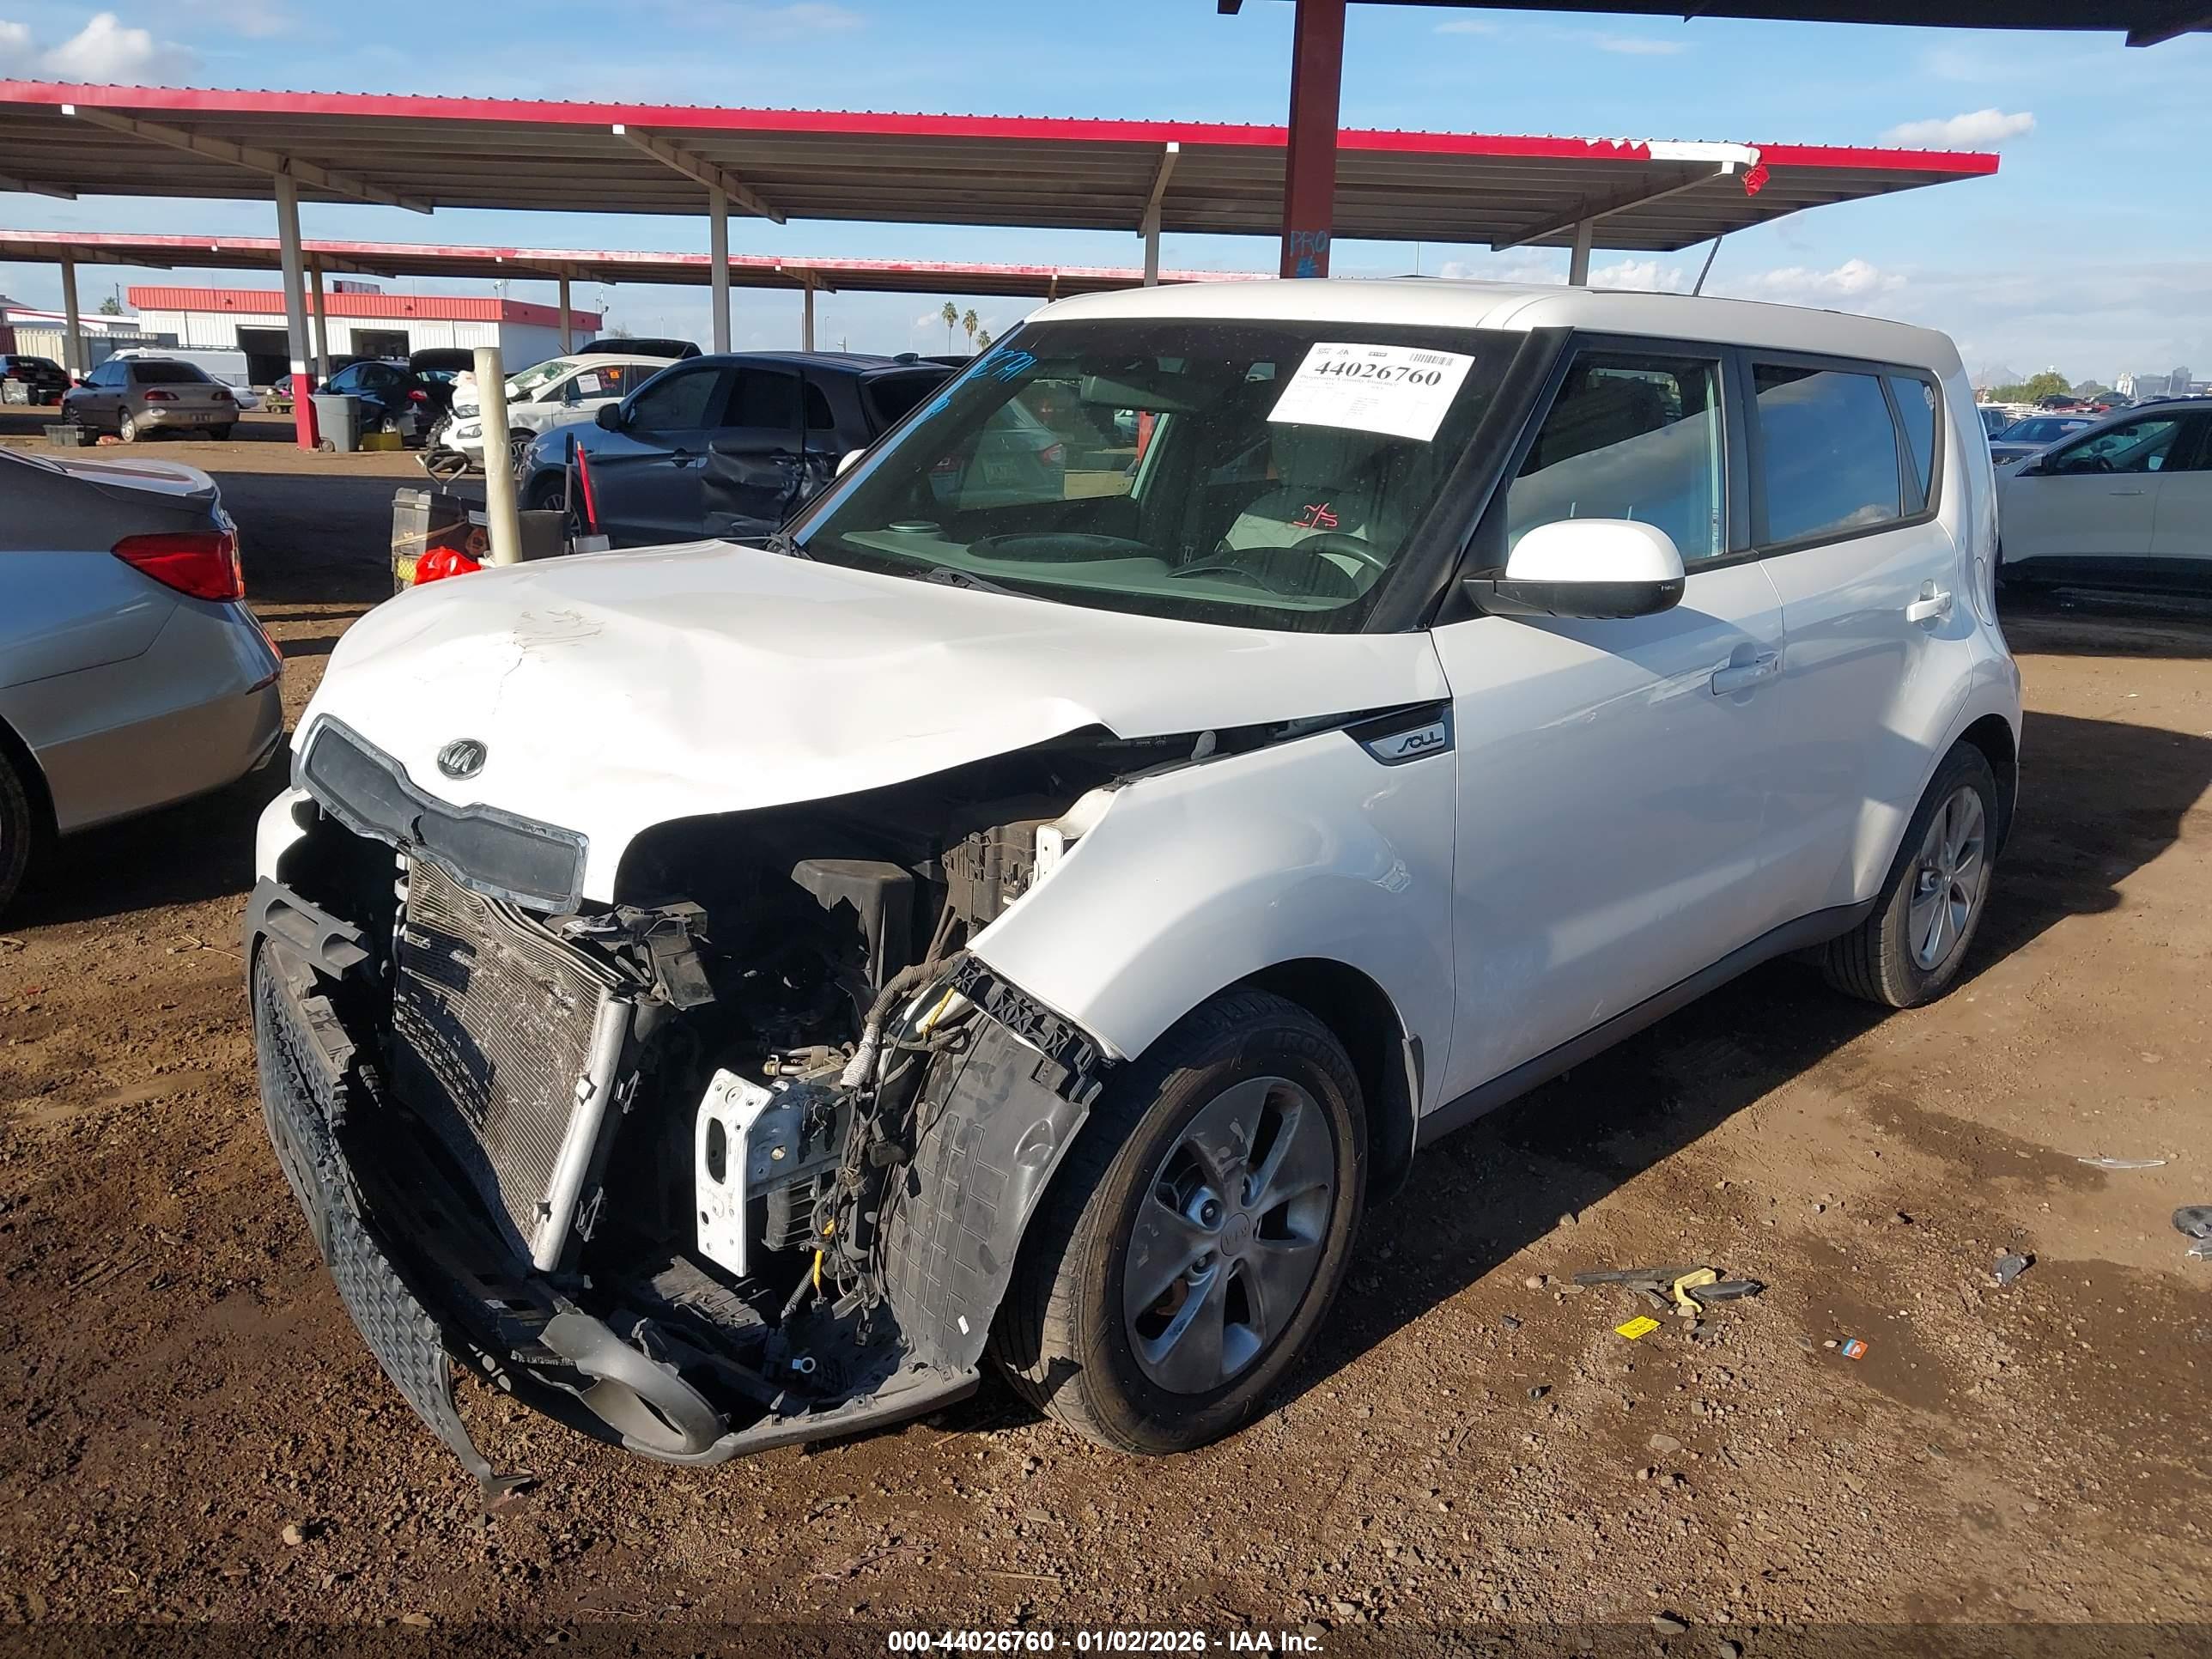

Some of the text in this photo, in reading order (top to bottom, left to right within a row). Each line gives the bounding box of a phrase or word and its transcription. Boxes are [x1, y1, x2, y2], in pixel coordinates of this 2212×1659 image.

[1314, 360, 1442, 386] 44026760
[1397, 731, 1443, 753] SOUL
[439, 741, 479, 774] KIA
